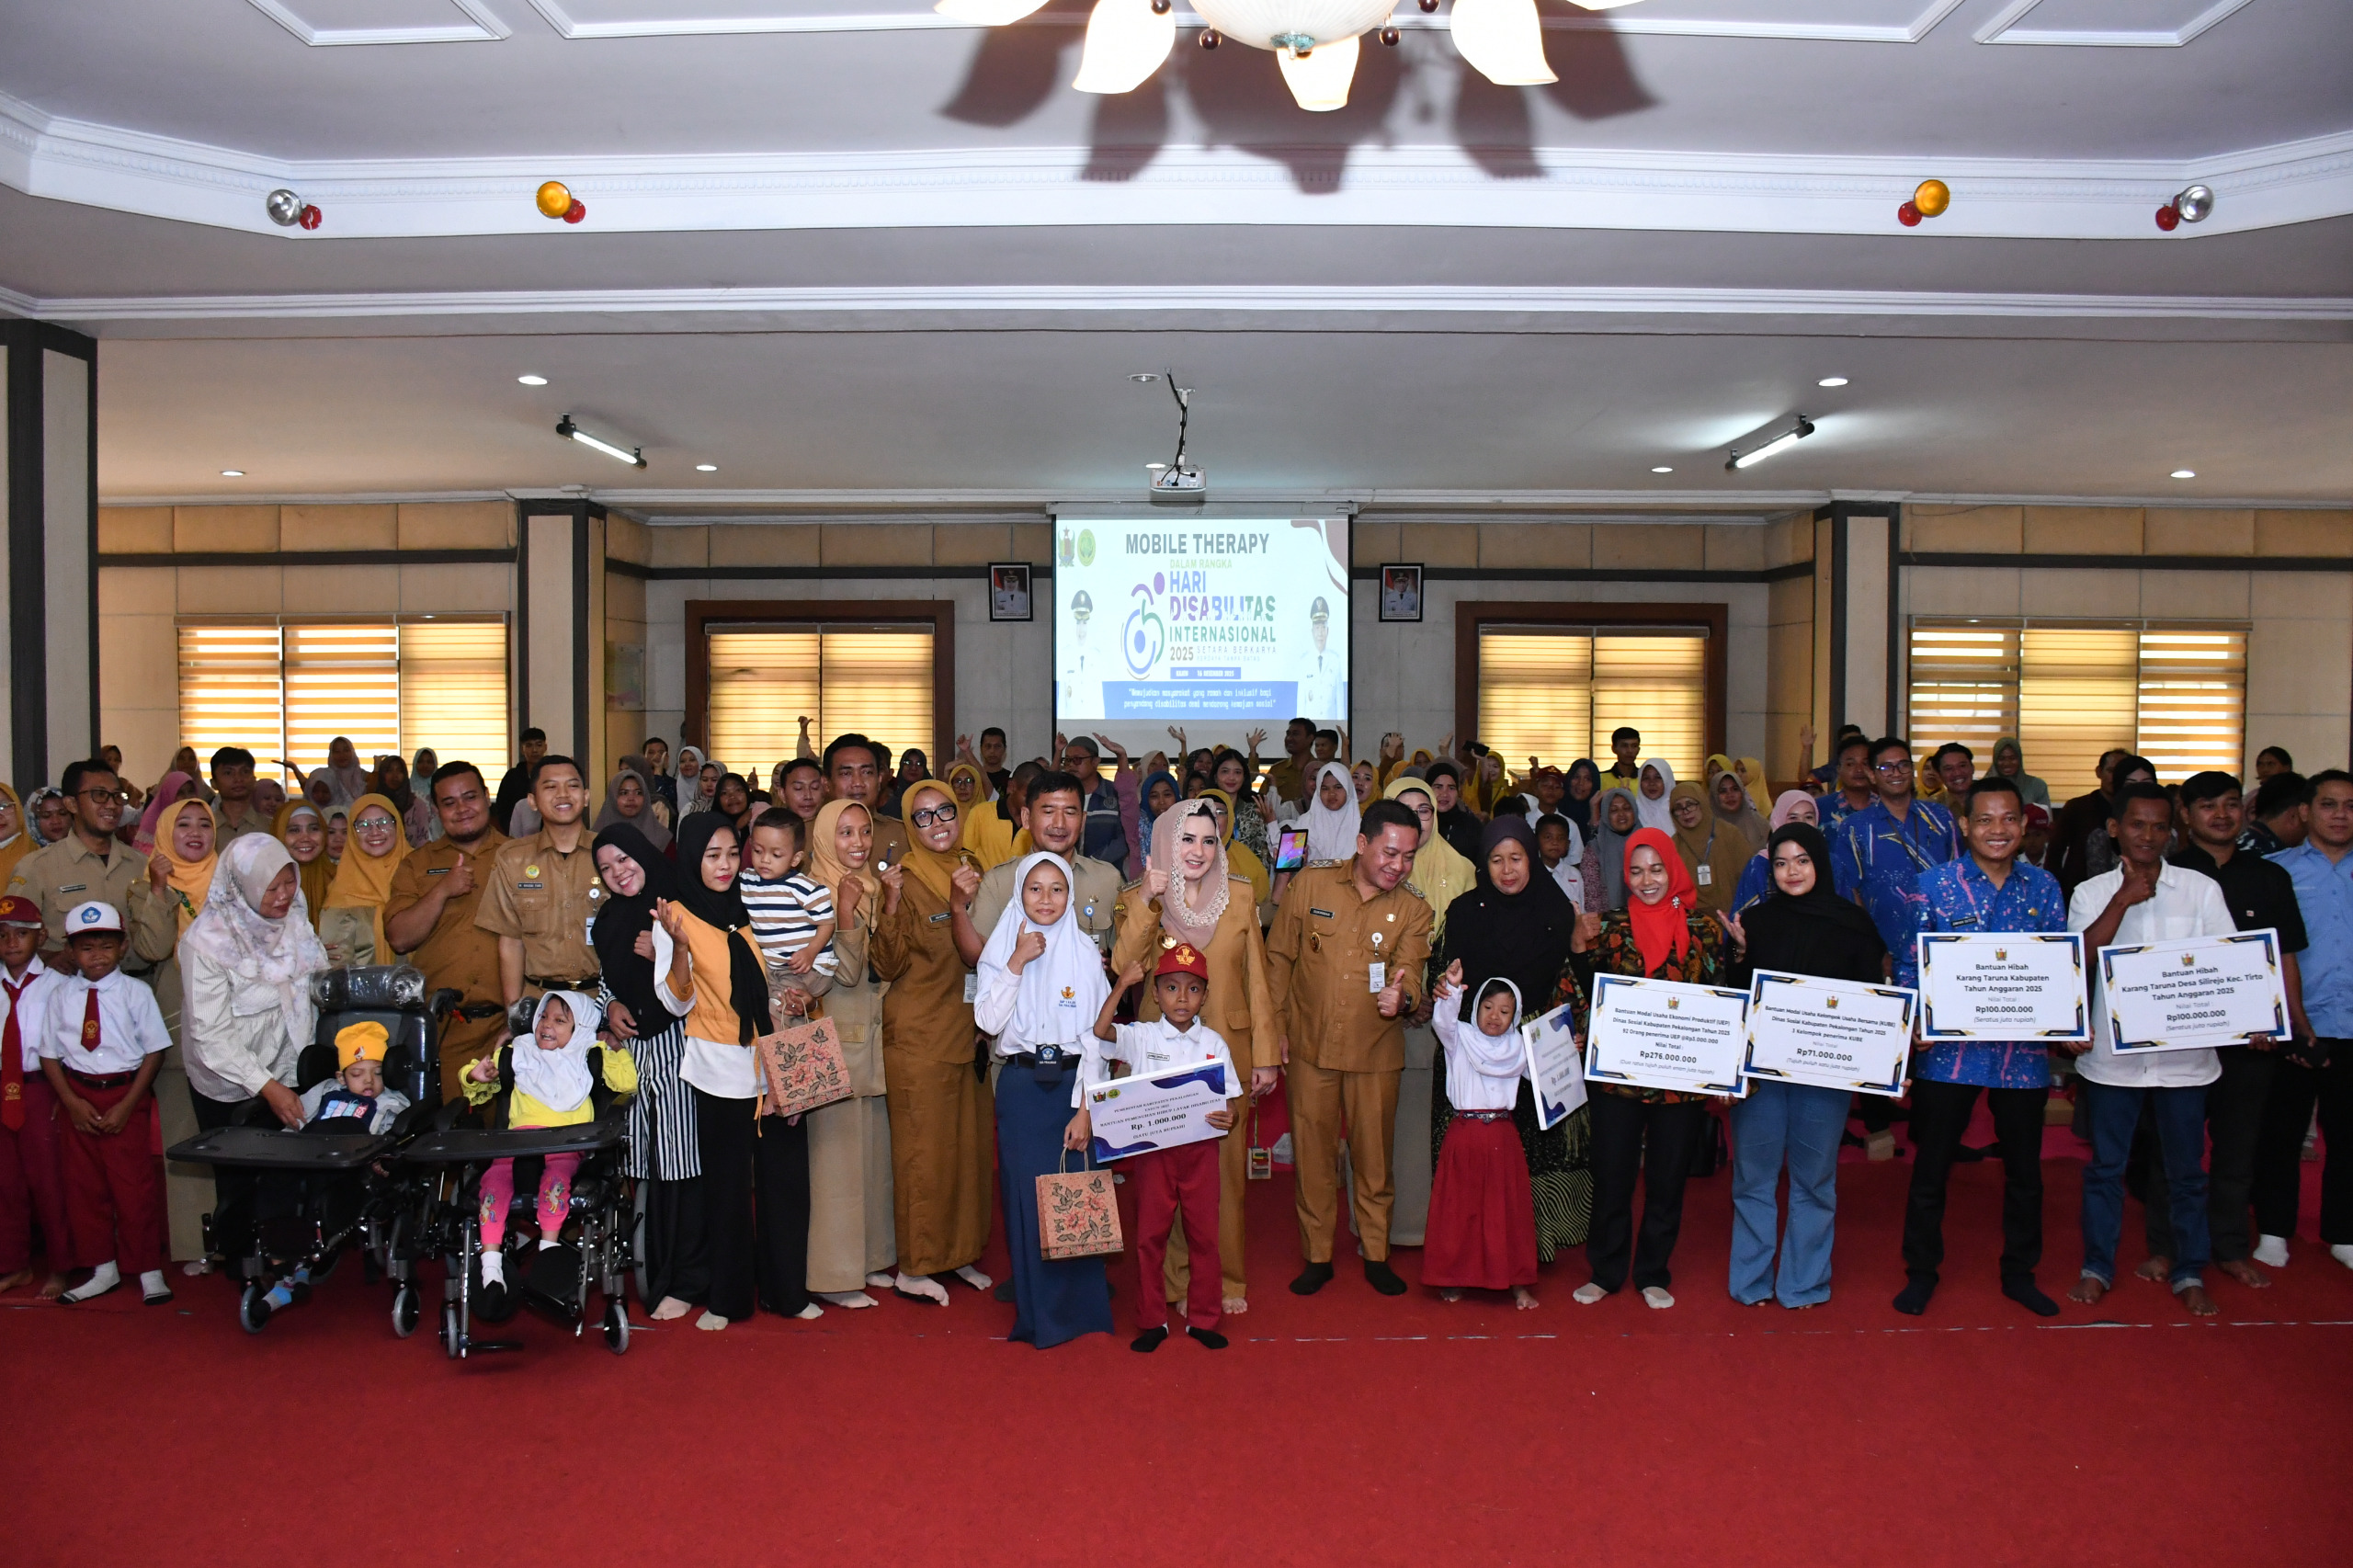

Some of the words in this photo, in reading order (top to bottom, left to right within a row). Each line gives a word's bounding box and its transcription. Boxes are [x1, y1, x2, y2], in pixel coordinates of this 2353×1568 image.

[1126, 533, 1187, 553] MOBILE
[1193, 533, 1269, 553] THERAPY
[1170, 559, 1196, 568] DALAM
[1199, 559, 1232, 568] RANGKA
[1170, 571, 1206, 593] HARI
[1170, 596, 1275, 621] DISABILITAS
[1170, 626, 1276, 642] INTERNASIONAL
[1170, 647, 1193, 661] 2025
[1155, 699, 1186, 708] disabilitas
[2199, 978, 2224, 986] Silirejo
[2177, 990, 2214, 999] Anggaran
[1692, 1017, 1715, 1025] Produktif
[2166, 1010, 2225, 1022] Rp100.000.000
[1643, 1021, 1671, 1029] Kabupaten
[1672, 1024, 1700, 1033] Pekalongan
[1802, 1020, 1827, 1028] Kabupaten
[1829, 1024, 1858, 1032] Pekalongan
[2207, 1020, 2230, 1028] rupiah)
[1797, 1028, 1822, 1037] Kelompok
[1824, 1032, 1847, 1040] penerima
[1640, 1051, 1697, 1063] Rp276.000.000
[1797, 1048, 1852, 1062] Rp71.000.000
[1148, 1113, 1187, 1127] 1.000.000
